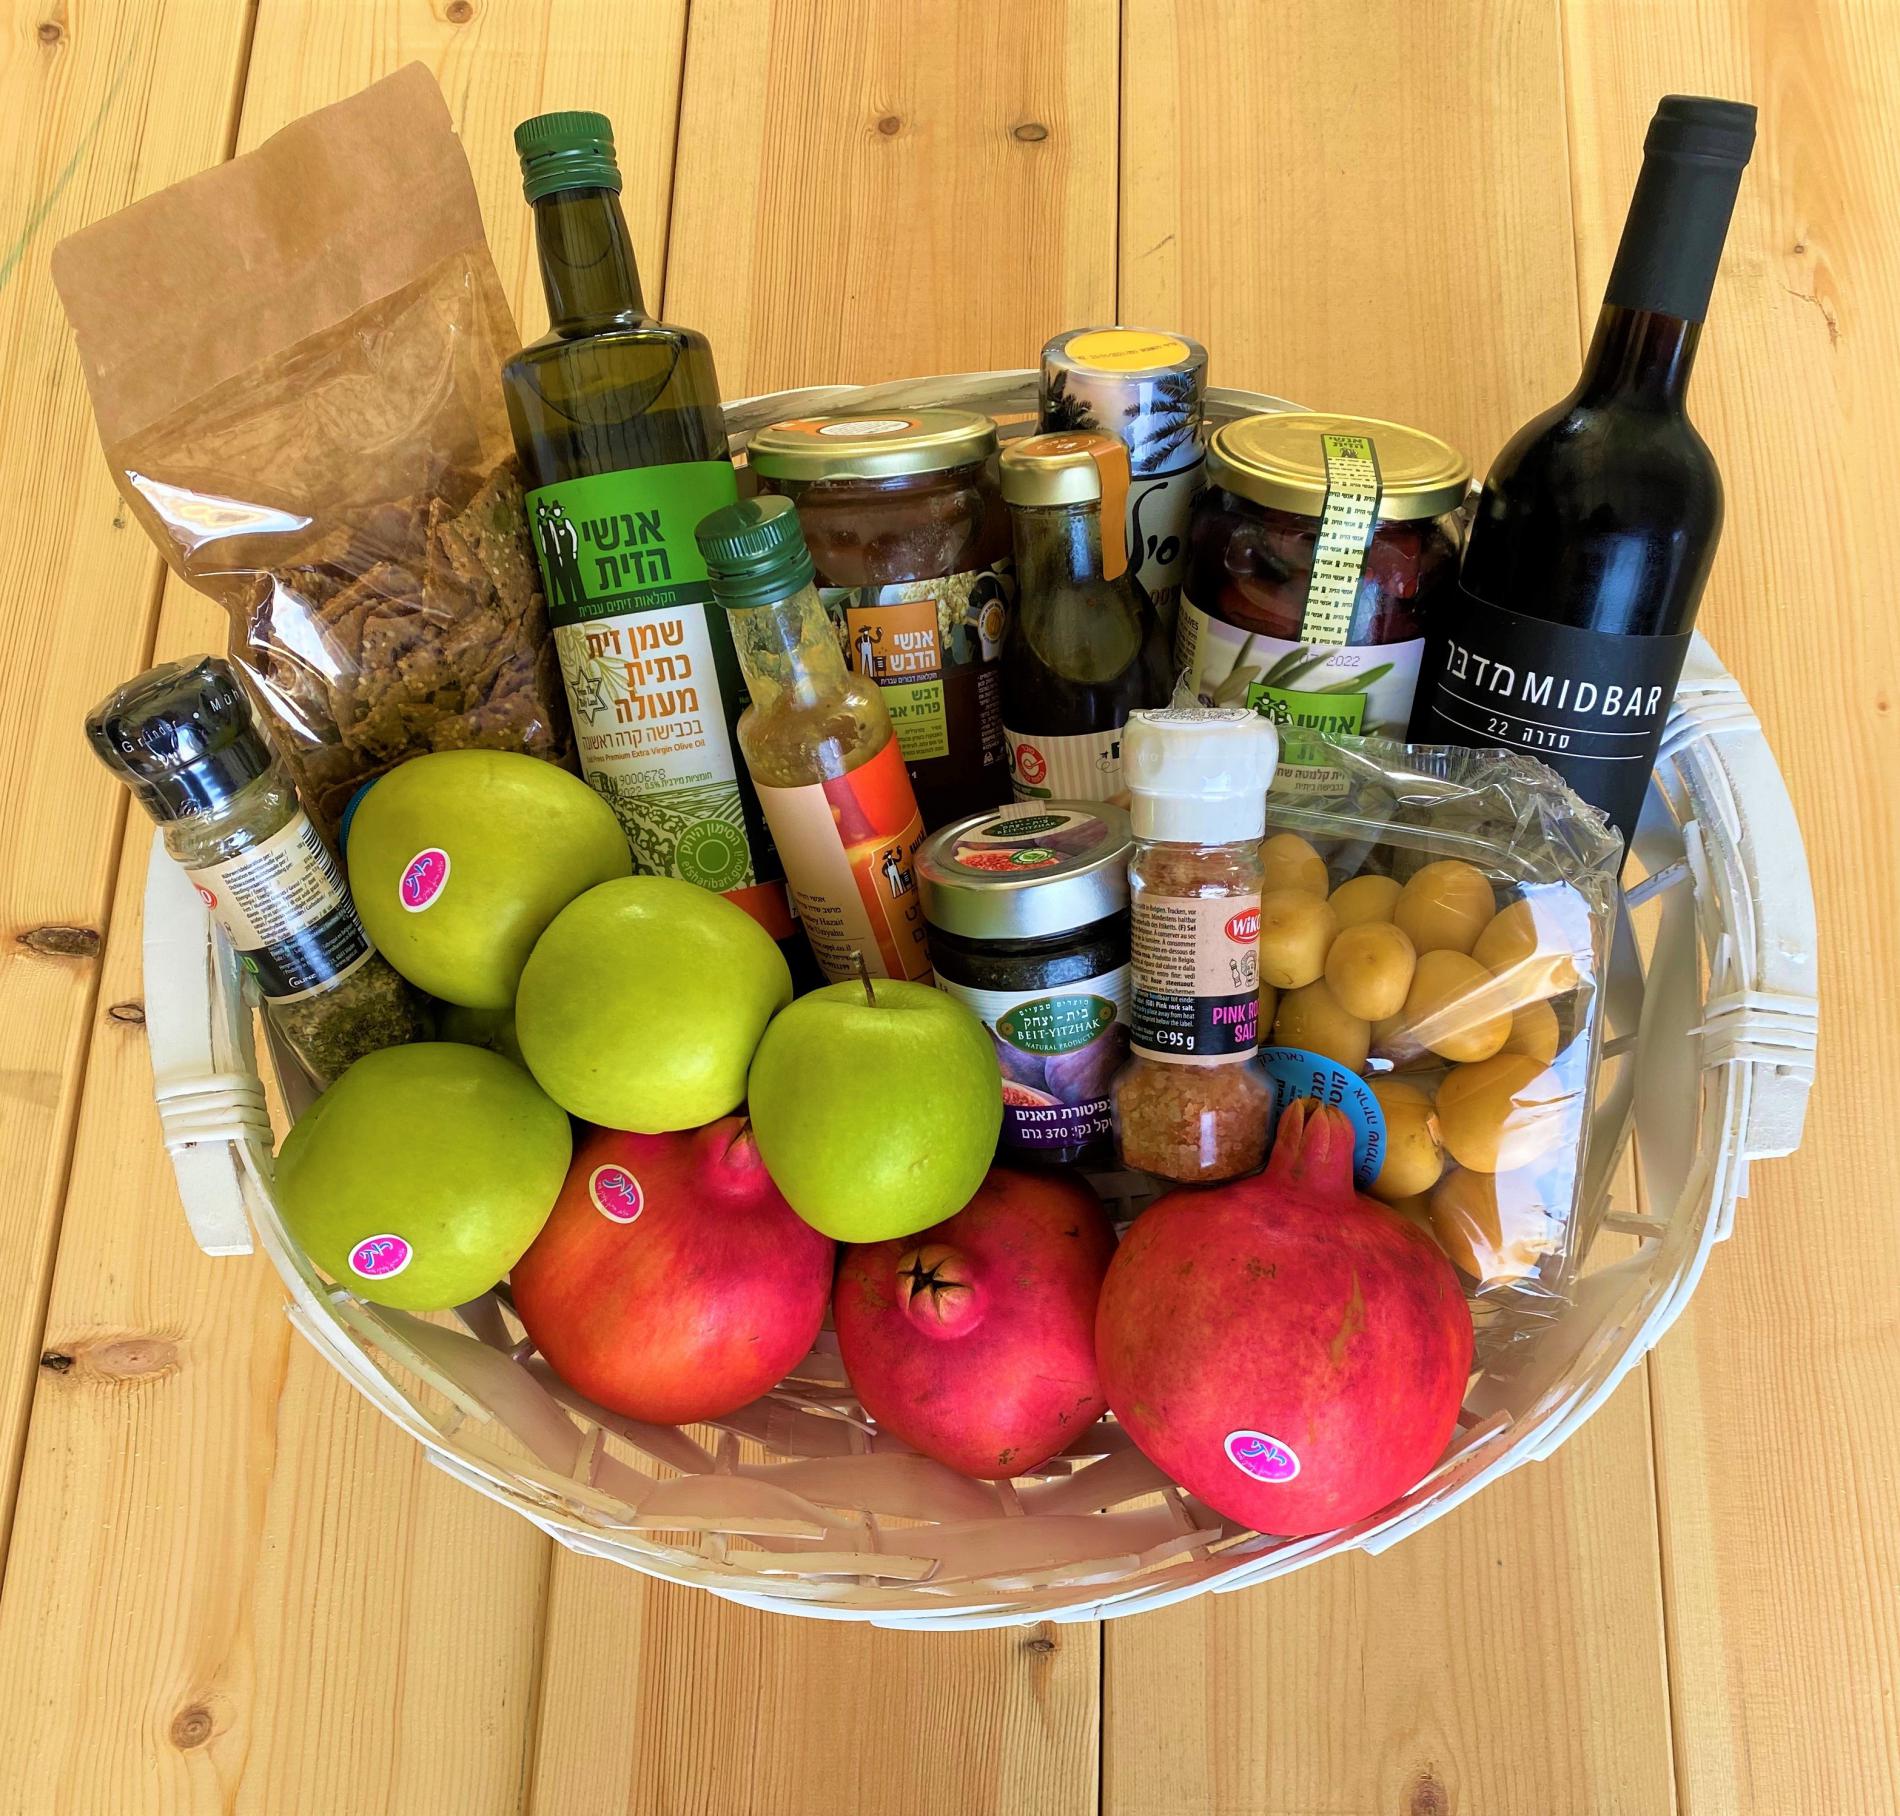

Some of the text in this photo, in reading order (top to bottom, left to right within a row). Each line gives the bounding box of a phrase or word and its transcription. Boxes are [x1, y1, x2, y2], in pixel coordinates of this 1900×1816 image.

[581, 509, 665, 550] אנשי
[595, 547, 672, 590] הזית
[578, 591, 677, 617] חקלאות זיתים עברית
[586, 619, 684, 660] שמן זית
[893, 629, 934, 651] אנשי
[624, 653, 692, 688] כתית
[890, 649, 936, 672] הדבש
[614, 687, 700, 724] מעולה
[911, 687, 939, 701] דבש
[1521, 672, 1662, 717] MIDBAR
[911, 701, 941, 716] פרחי
[121, 720, 177, 754] Grinder
[581, 719, 704, 751] בכבישה קרה ראשונה
[1487, 718, 1571, 749] סדרה 22
[632, 749, 651, 759] Extra
[651, 745, 673, 757] Virgin
[674, 741, 694, 752] Olive
[695, 738, 706, 748] Oil
[680, 823, 741, 855] הסימון הירוק
[1156, 1001, 1167, 1009] Pink
[1182, 1004, 1195, 1012] salt.
[1171, 1011, 1182, 1019] from
[1183, 1012, 1195, 1020] heat
[1212, 1001, 1259, 1025] PINK RO
[1018, 1018, 1101, 1040] BEIT-YITZHAK
[1235, 1020, 1257, 1043] SALT
[1025, 1032, 1095, 1051] NATURAL PRODUCTS
[1169, 1032, 1184, 1046] 95
[1186, 1036, 1195, 1050] g
[1015, 1109, 1057, 1122] תאנים
[1353, 1087, 1378, 1125] אריזה
[1021, 1128, 1042, 1140] גרם
[1045, 1127, 1068, 1139] 370
[1071, 1123, 1091, 1139] נקי:
